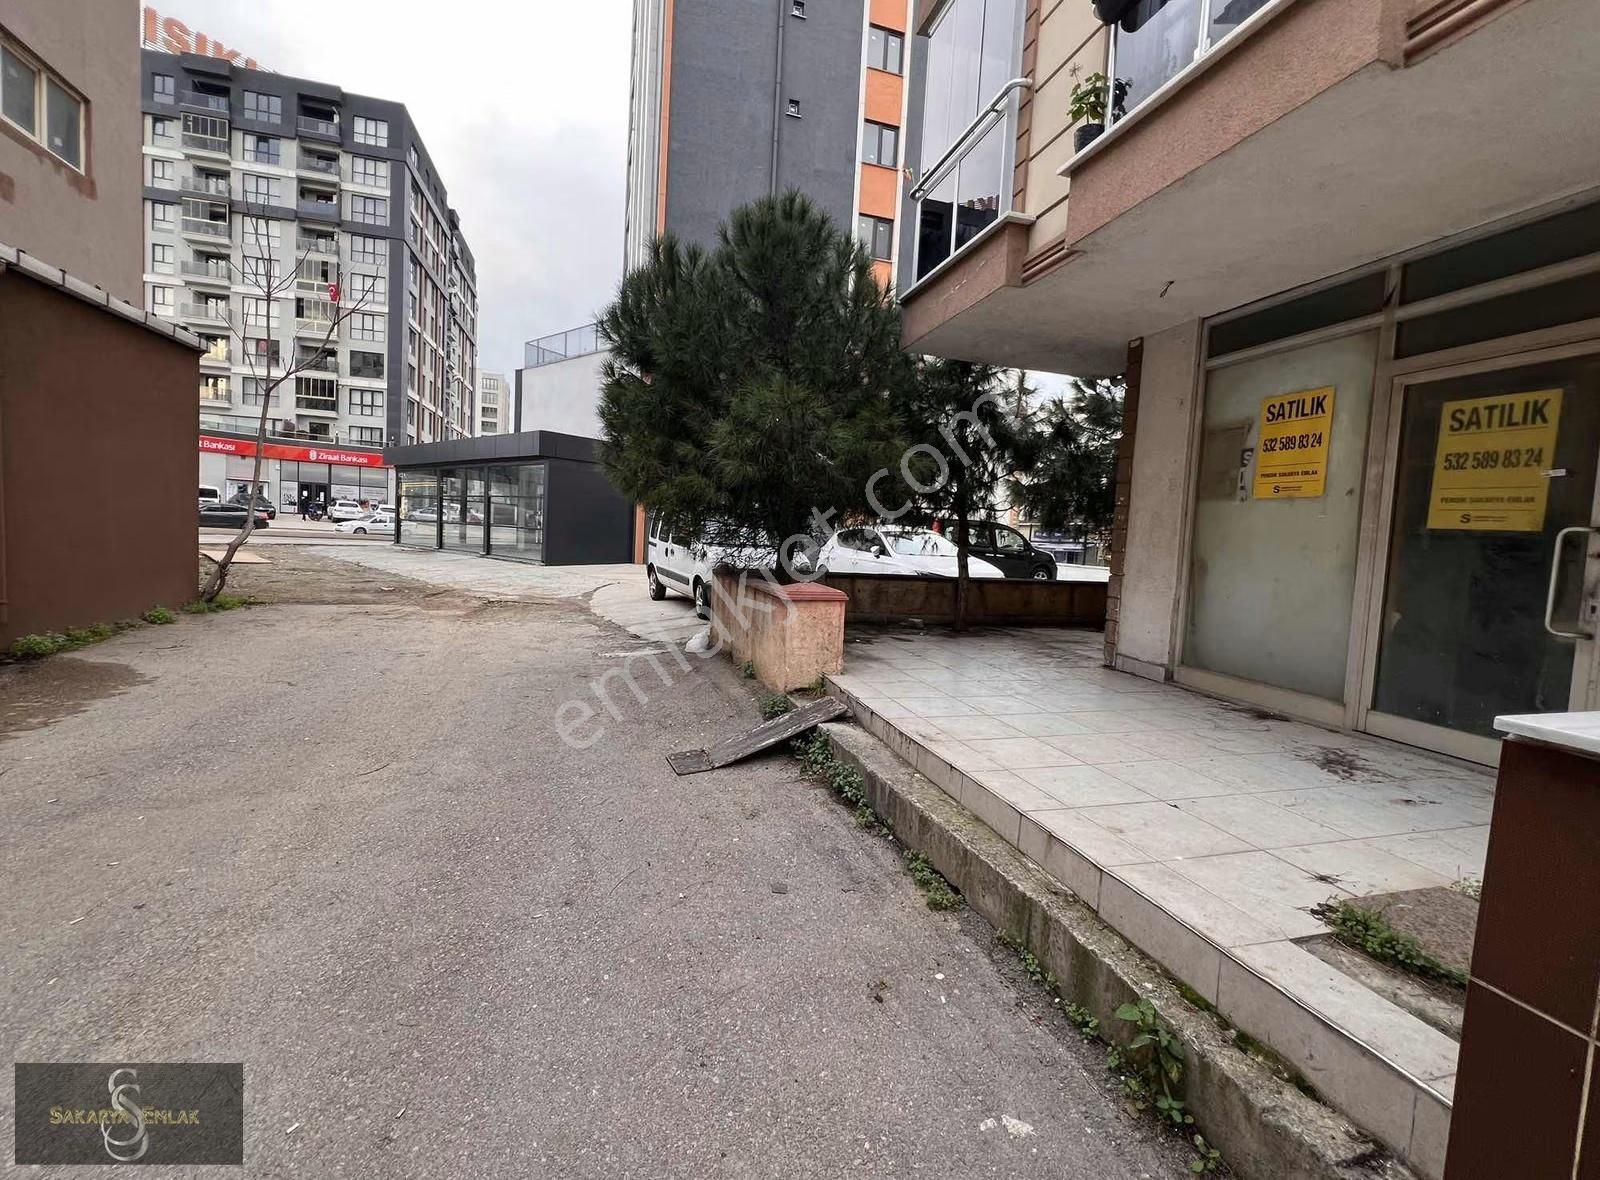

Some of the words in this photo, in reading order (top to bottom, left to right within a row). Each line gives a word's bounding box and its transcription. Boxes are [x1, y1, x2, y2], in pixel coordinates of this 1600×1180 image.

[1266, 395, 1327, 422] SATILIK
[1450, 399, 1551, 432] SATILIK
[203, 440, 236, 451] Bankası
[1262, 437, 1278, 453] 532
[1279, 436, 1297, 451] 589
[1298, 434, 1310, 449] 83
[1311, 432, 1323, 448] 24
[318, 452, 340, 462] Ziraat
[1443, 453, 1470, 471] 532
[1471, 451, 1500, 470] 589
[1501, 449, 1522, 468] 83
[1524, 447, 1544, 467] 24
